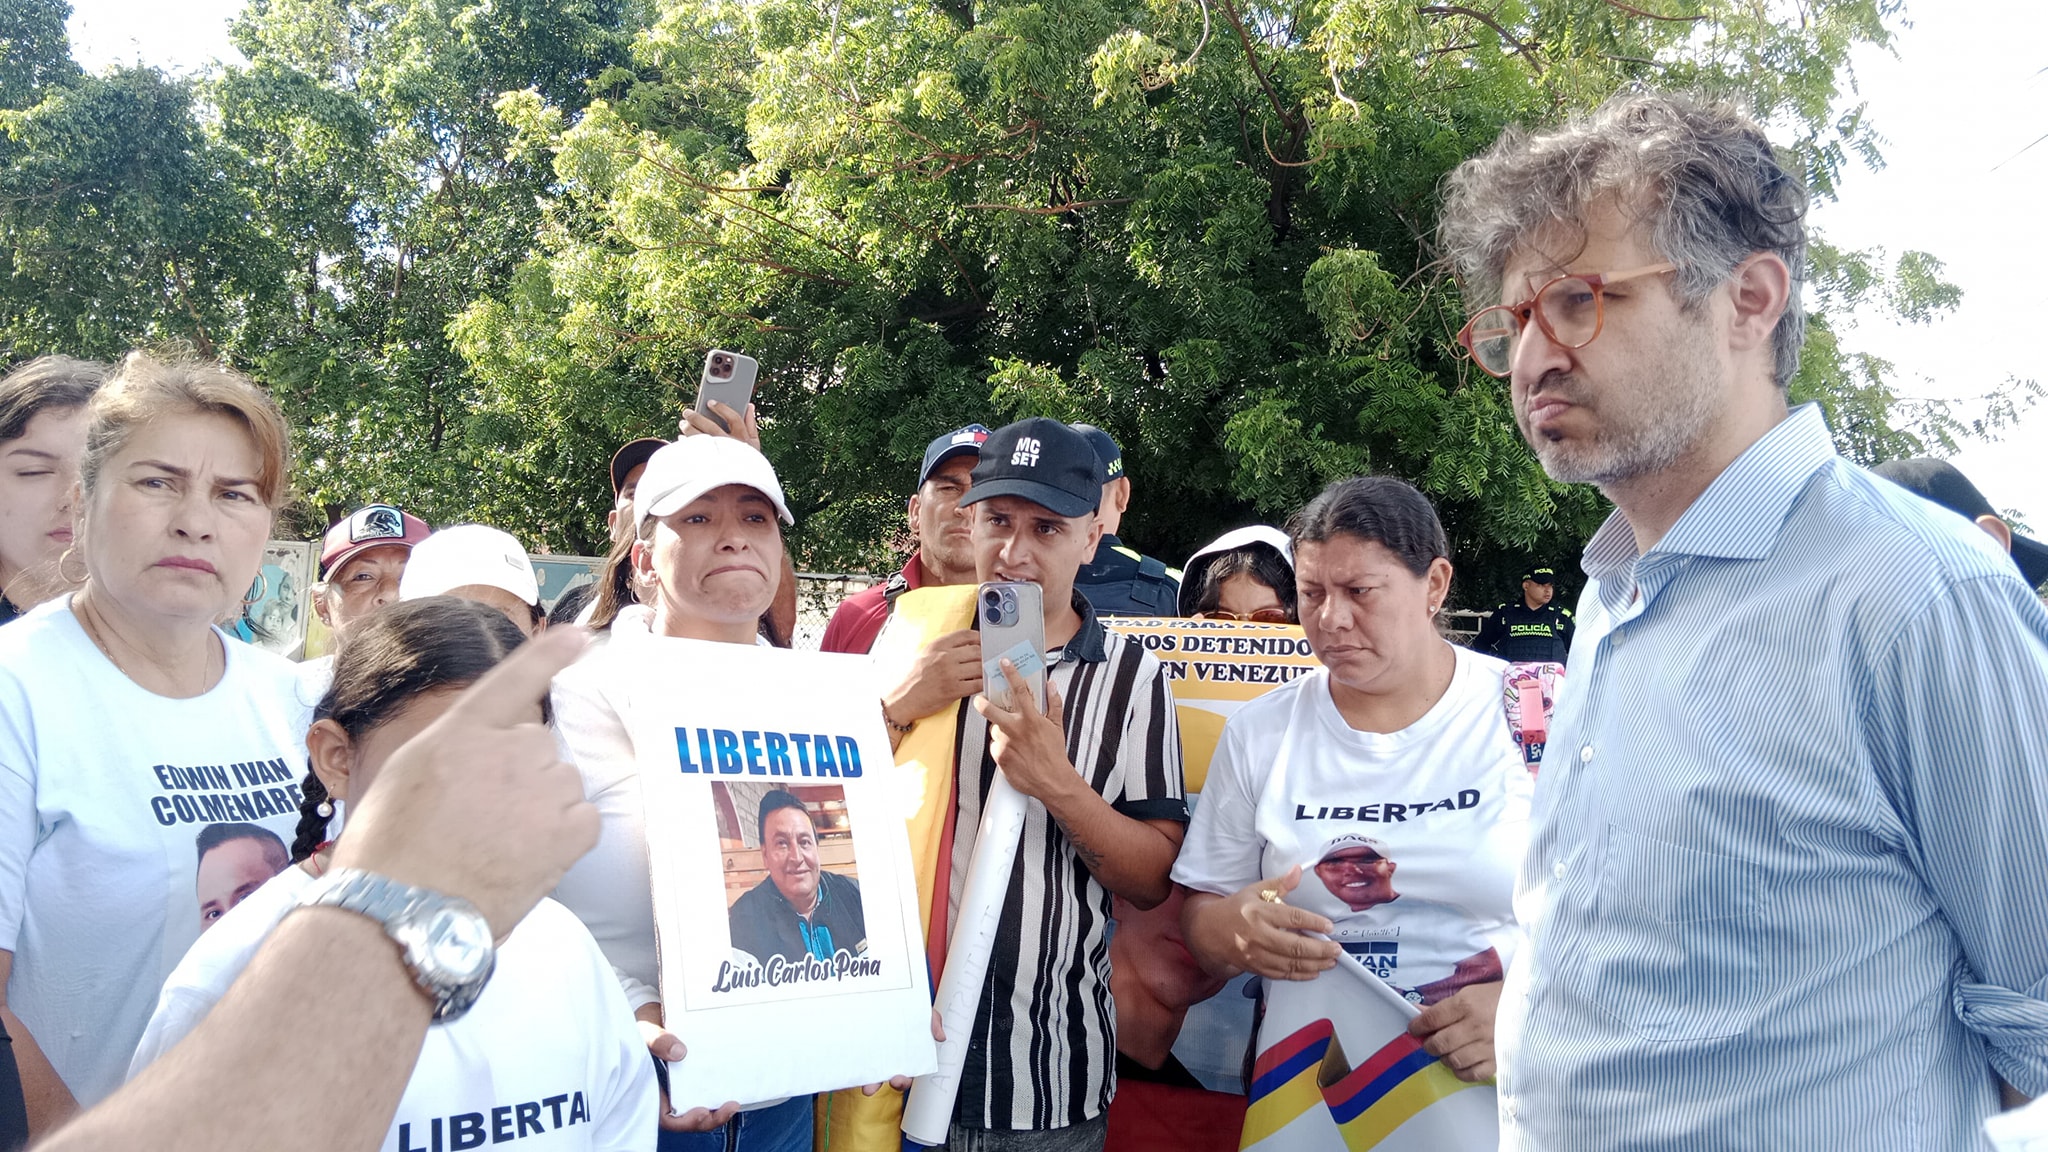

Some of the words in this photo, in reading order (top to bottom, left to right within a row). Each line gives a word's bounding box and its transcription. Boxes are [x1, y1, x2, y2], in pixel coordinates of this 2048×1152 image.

[1011, 451, 1040, 467] SET
[1016, 437, 1040, 453] MC
[1511, 624, 1551, 632] POLICÍA
[675, 727, 863, 778] LIBERTAD
[153, 764, 232, 790] EDWIN
[230, 757, 293, 787] IVAN
[1295, 789, 1481, 823] LIBERTAD
[712, 960, 761, 993] Luis
[767, 955, 830, 987] Carlos
[835, 951, 881, 982] Peña
[399, 1091, 590, 1152] LIBERTA
